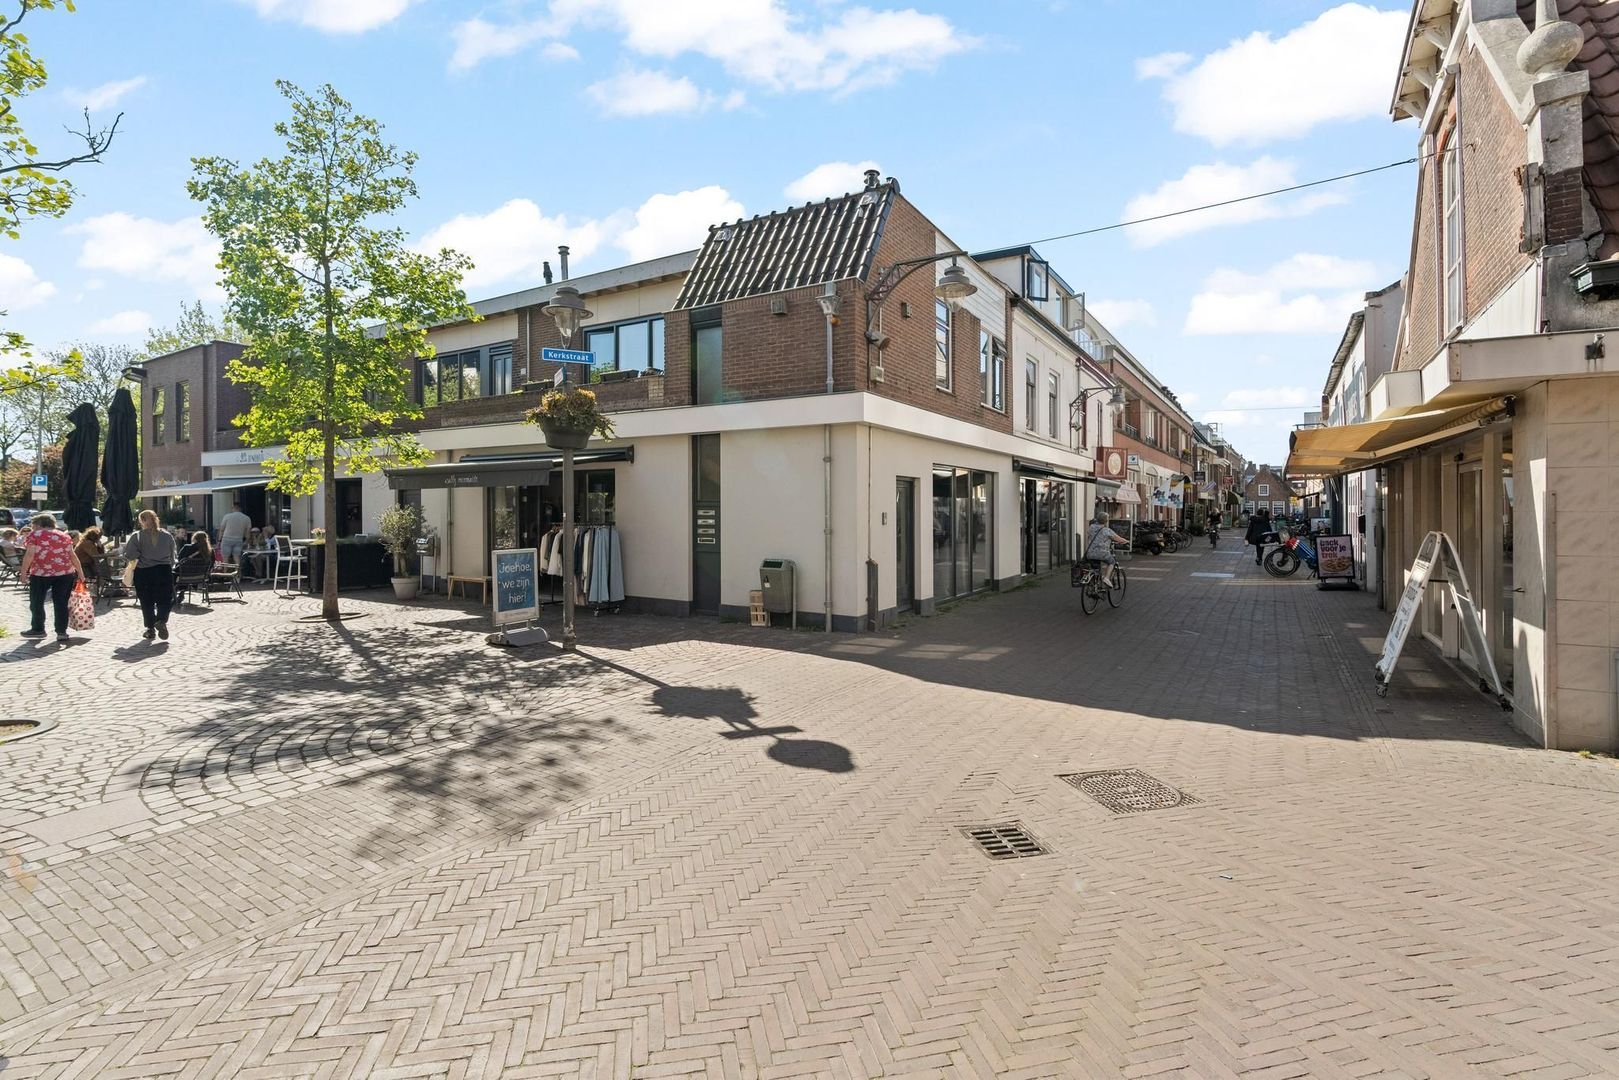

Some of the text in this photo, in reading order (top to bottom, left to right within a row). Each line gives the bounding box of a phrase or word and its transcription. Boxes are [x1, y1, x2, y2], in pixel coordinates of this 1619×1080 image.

[548, 351, 589, 361] Kerkstraat
[35, 476, 44, 485] P
[502, 577, 530, 589] we zijn
[508, 592, 526, 604] hier!
